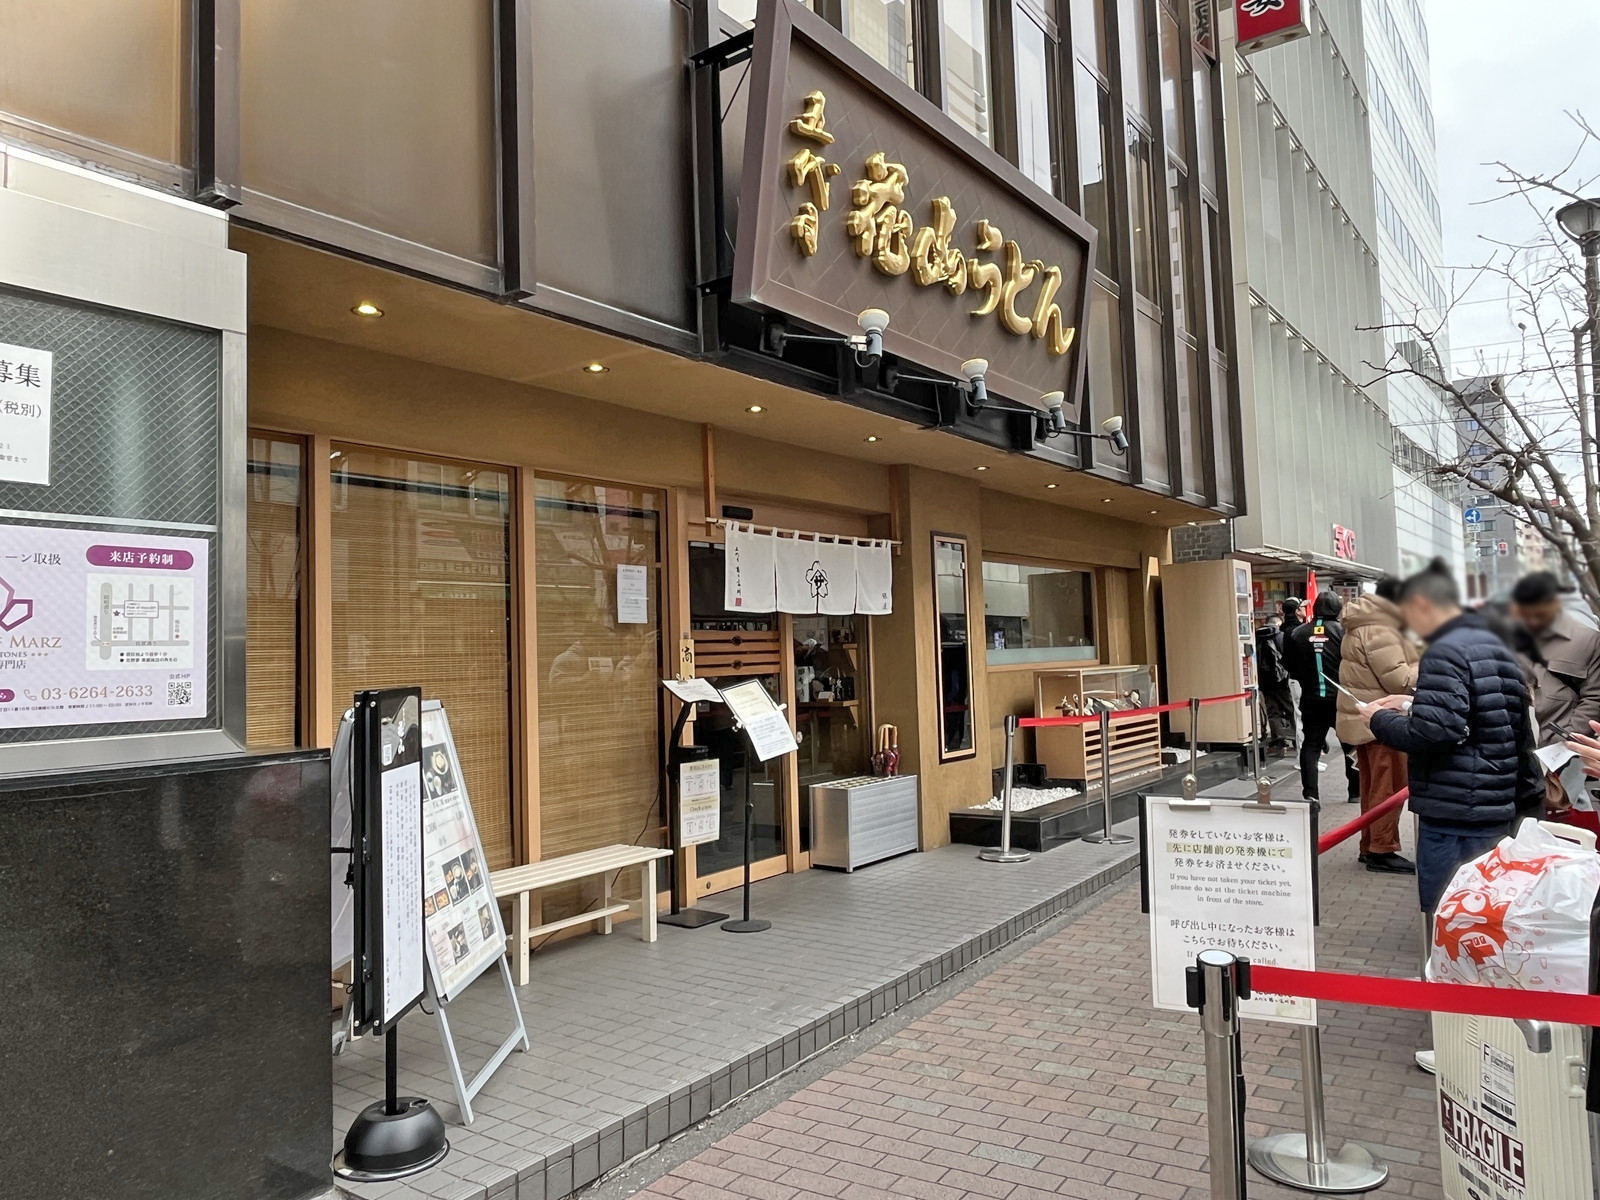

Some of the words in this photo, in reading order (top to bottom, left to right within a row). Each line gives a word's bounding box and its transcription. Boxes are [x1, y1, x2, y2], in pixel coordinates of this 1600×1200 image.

[0, 553, 61, 565] ーン取扱
[110, 550, 174, 565] 来店予約制
[9, 635, 62, 648] MARZ
[0, 659, 26, 669] 門店
[41, 685, 153, 700] 03-6264-2633
[1168, 828, 1290, 843] 発券をしていないお客様は、
[1172, 843, 1286, 857] 先に店舗前の発券機にて
[1174, 857, 1286, 873] 発券をお済ませください。
[1170, 919, 1295, 937] 呼び出し中になったお客様は
[1183, 935, 1283, 952] こちらでお待ちください。
[1453, 1102, 1525, 1186] FRAGILE
